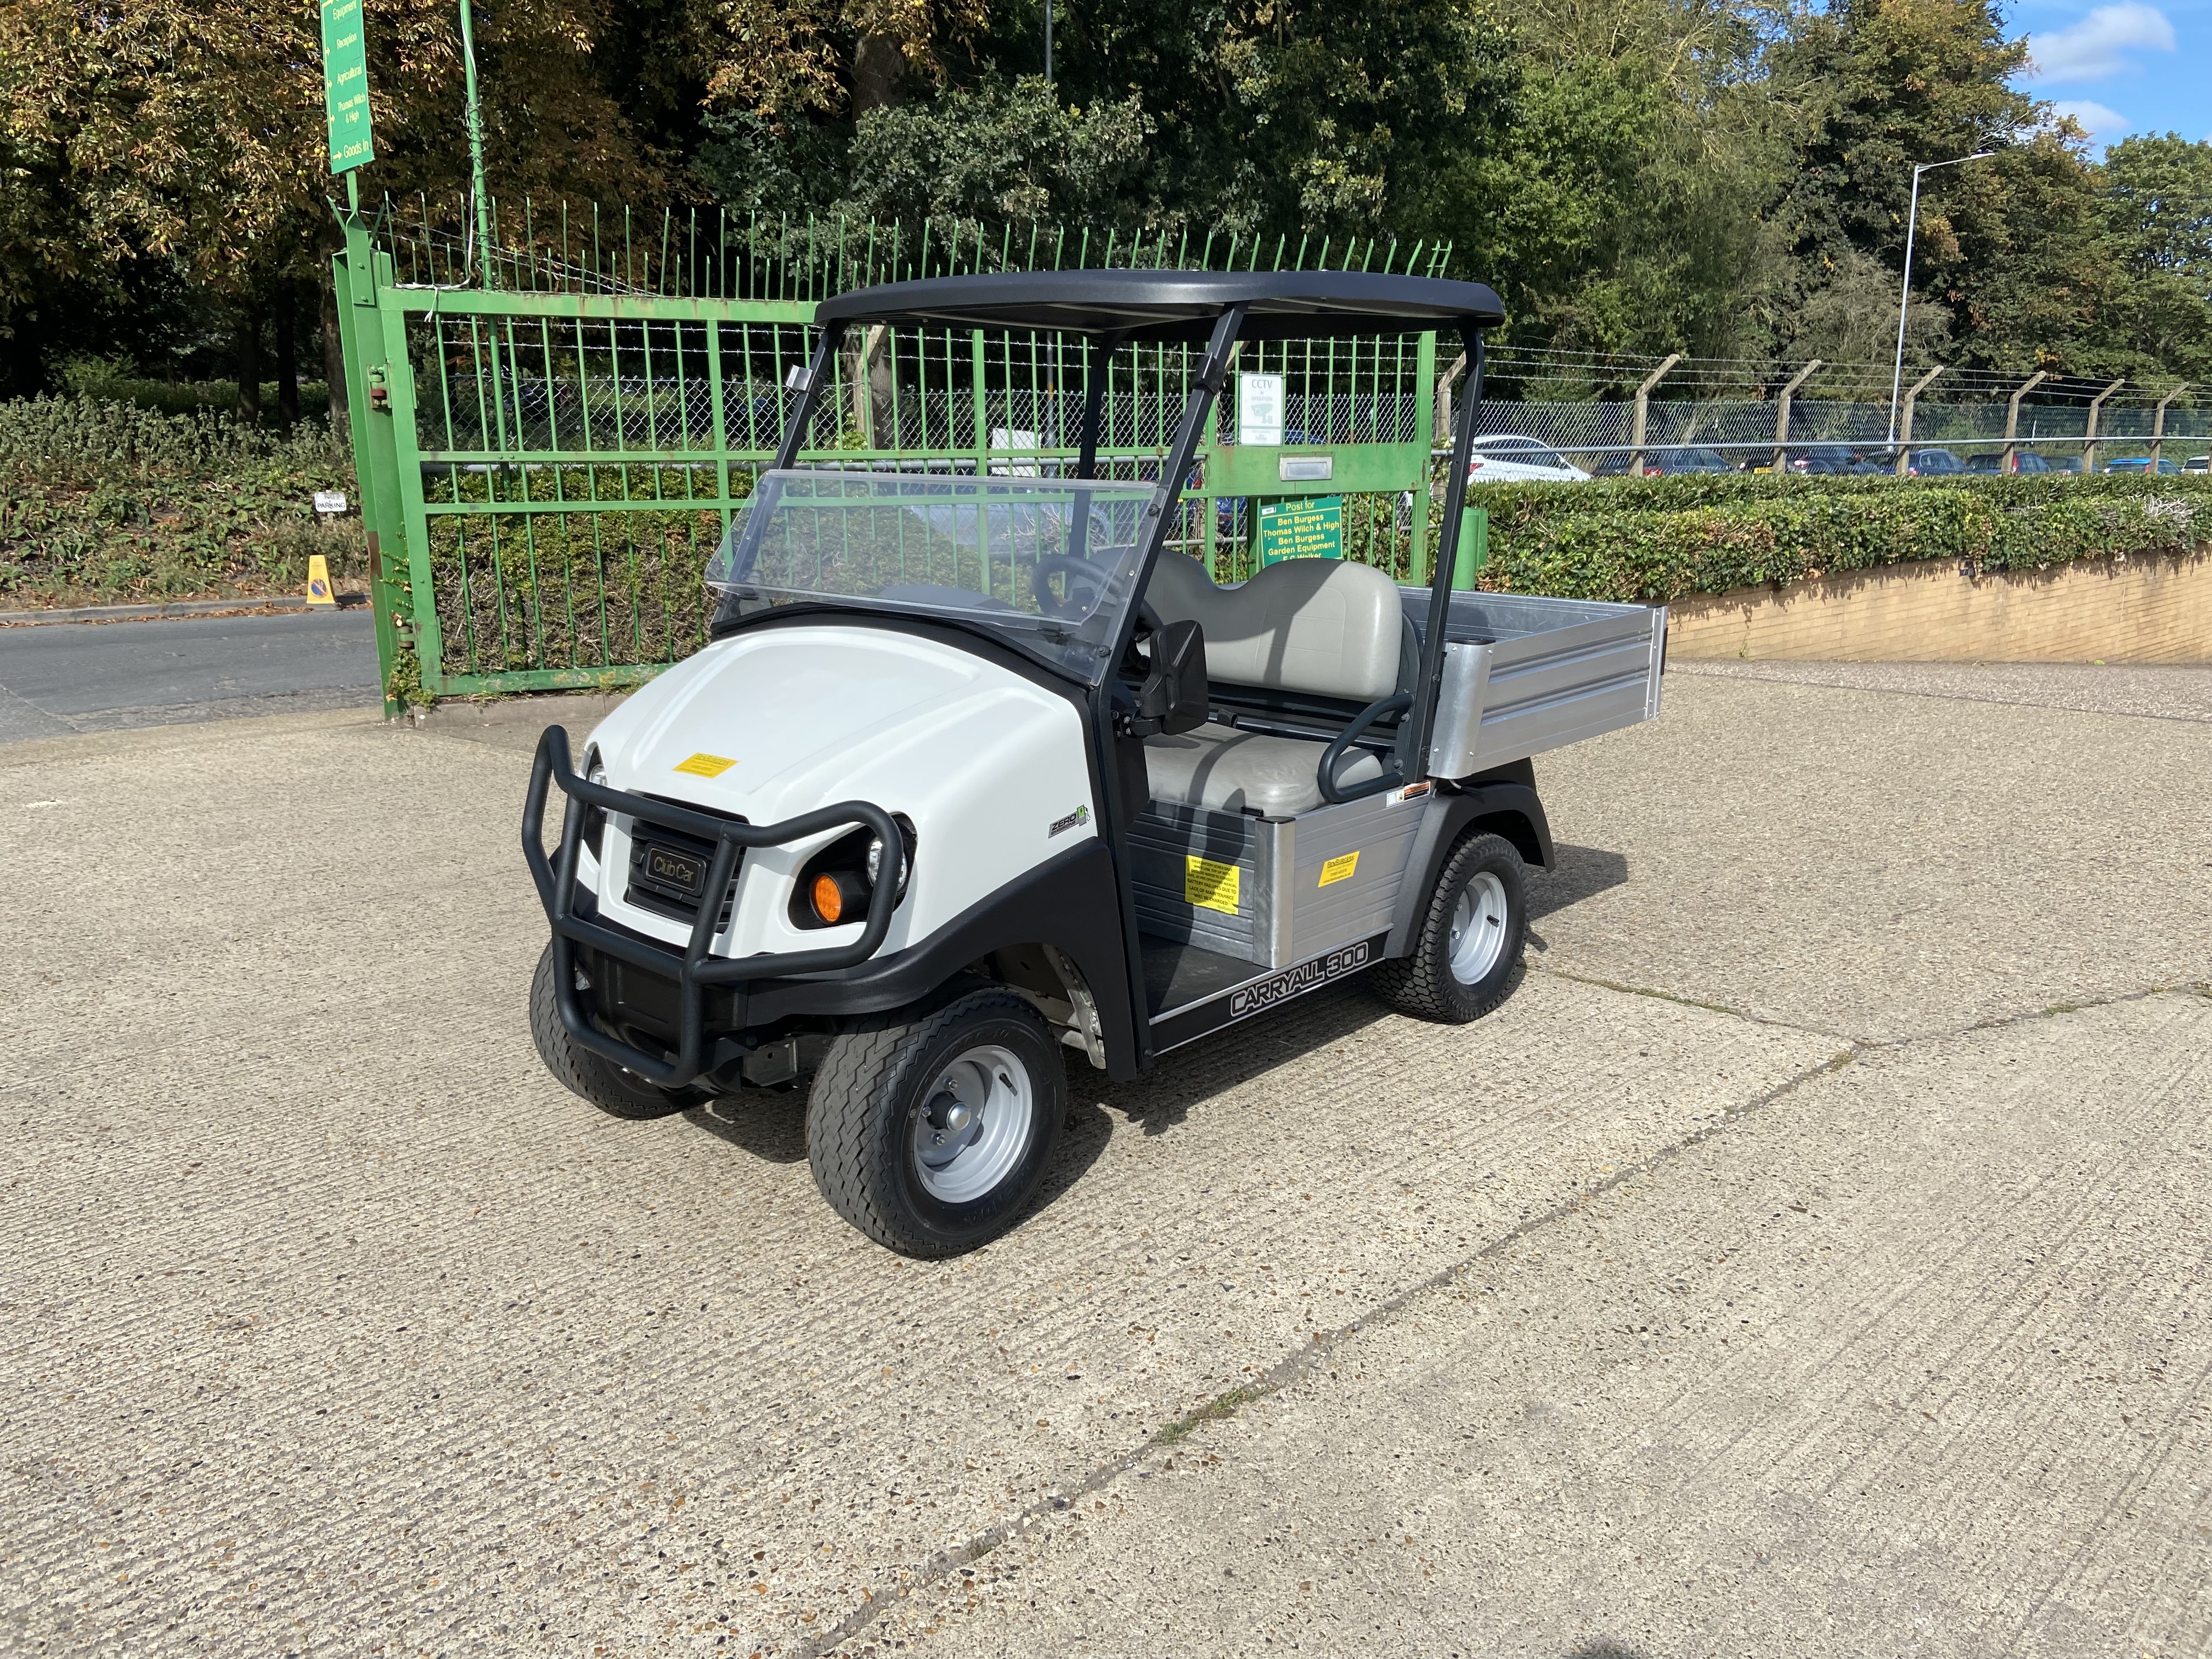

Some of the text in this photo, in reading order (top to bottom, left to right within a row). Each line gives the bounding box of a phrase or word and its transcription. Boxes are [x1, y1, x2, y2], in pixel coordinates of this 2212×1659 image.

[333, 0, 357, 20] Equipment
[337, 32, 357, 49] Reception
[337, 62, 362, 86] Agricultural
[337, 99, 354, 112] Thomas
[345, 110, 359, 123] & High
[343, 138, 369, 159] Goods In
[1252, 379, 1273, 389] CCTV
[1285, 500, 1315, 511] Post for
[1277, 514, 1324, 526] Ben Burgess
[1263, 528, 1293, 538] Thomas
[1316, 523, 1322, 531] &
[1323, 520, 1340, 531] High
[1278, 533, 1325, 545] Ben Burgess
[1268, 540, 1335, 556] Garden Equipment
[1051, 812, 1076, 831] ZERO
[654, 856, 694, 882] Club Car
[1205, 889, 1234, 901] MAINTENANCE
[1209, 896, 1228, 905] CHARGED
[1230, 941, 1369, 1017] CARRYALL 300
